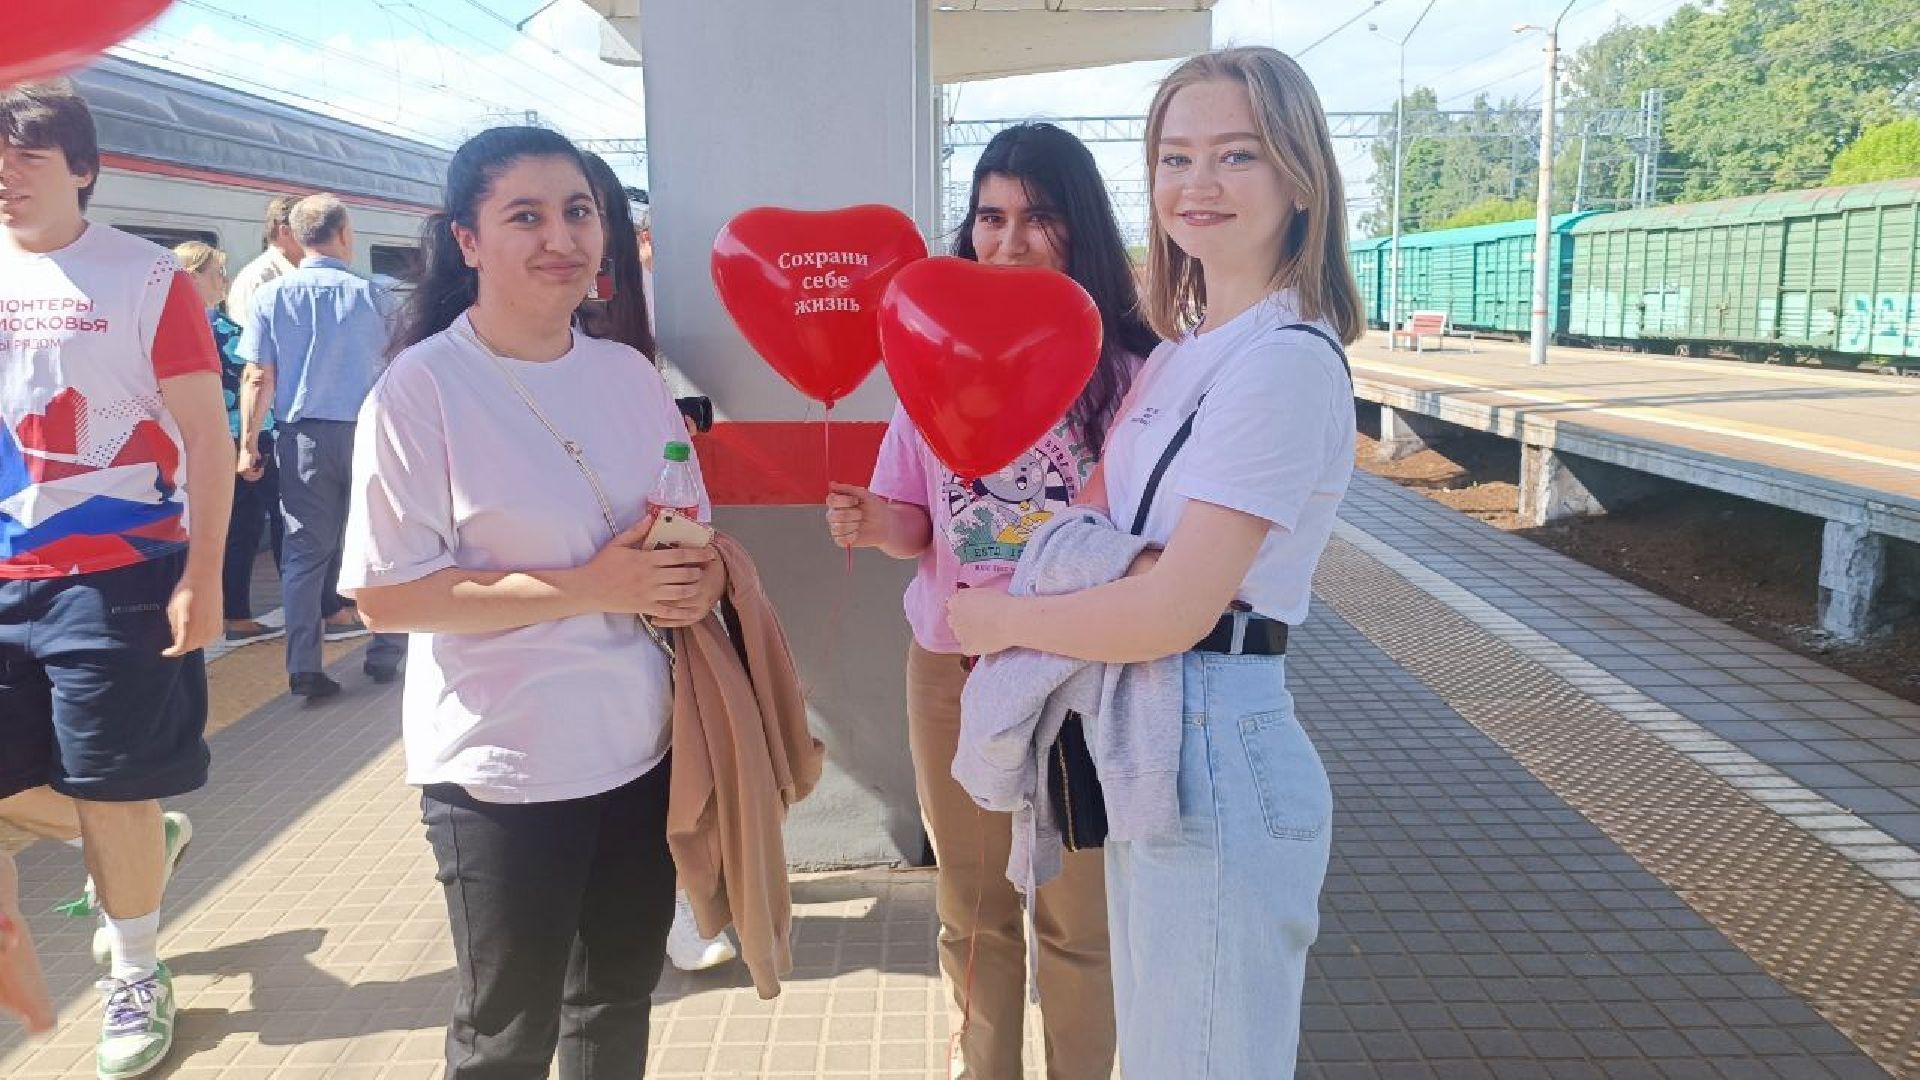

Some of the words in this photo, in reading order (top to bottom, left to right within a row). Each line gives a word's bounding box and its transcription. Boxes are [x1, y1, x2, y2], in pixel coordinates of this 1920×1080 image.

[778, 251, 869, 269] Сохрани
[802, 270, 850, 290] себе
[794, 297, 860, 316] жизнь
